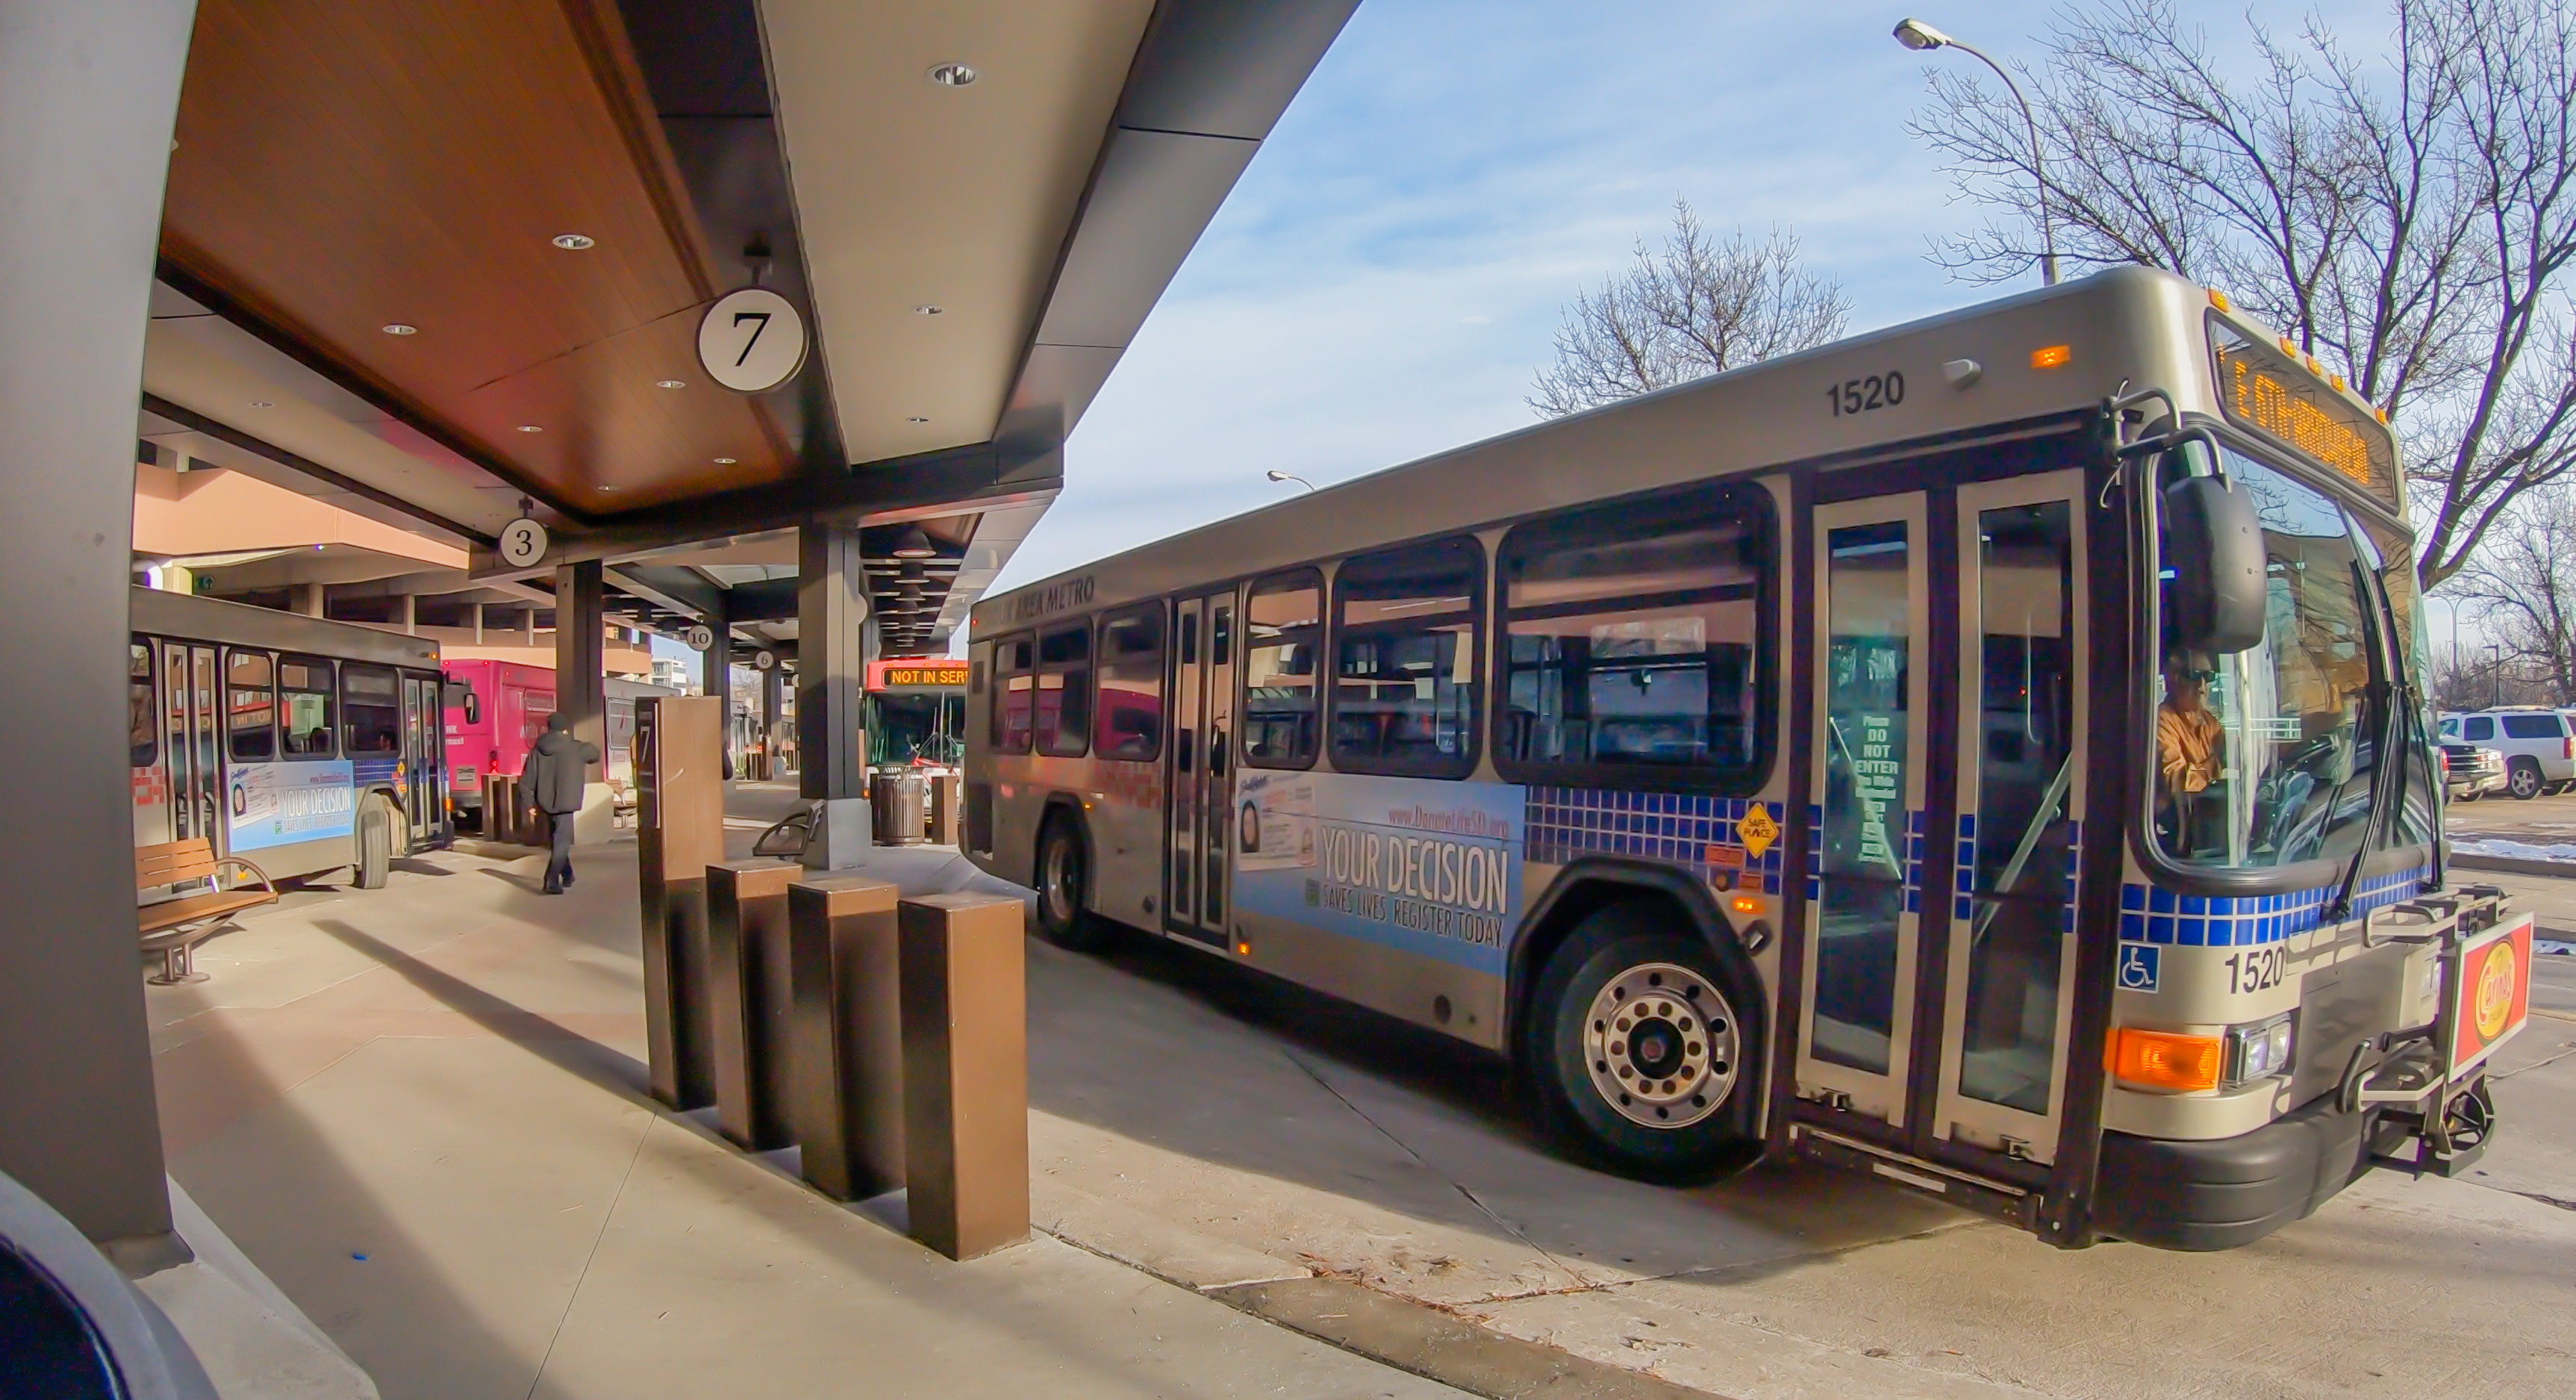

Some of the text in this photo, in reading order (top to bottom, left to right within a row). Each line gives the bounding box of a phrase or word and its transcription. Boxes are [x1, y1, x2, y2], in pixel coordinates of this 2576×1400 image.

[734, 312, 771, 367] 7
[1827, 370, 1904, 417] 1520
[516, 529, 532, 556] 3
[1016, 591, 1043, 619] AREA
[1047, 576, 1095, 612] METRO
[691, 633, 708, 644] 10
[761, 656, 768, 665] 6
[892, 671, 968, 683] NOT IN SER
[1868, 729, 1886, 742] DO
[1863, 744, 1891, 758] NOT
[1856, 760, 1898, 774] ENTER
[282, 786, 351, 818] YOUR DECISION
[1744, 827, 1771, 838] PLACE
[1322, 827, 1380, 889] YOUR
[1388, 835, 1509, 915] DECISION
[1323, 886, 1353, 914] SAVES
[1394, 898, 1453, 936] REGISTER
[1459, 911, 1506, 950] TODAY.
[2225, 945, 2284, 995] 1520
